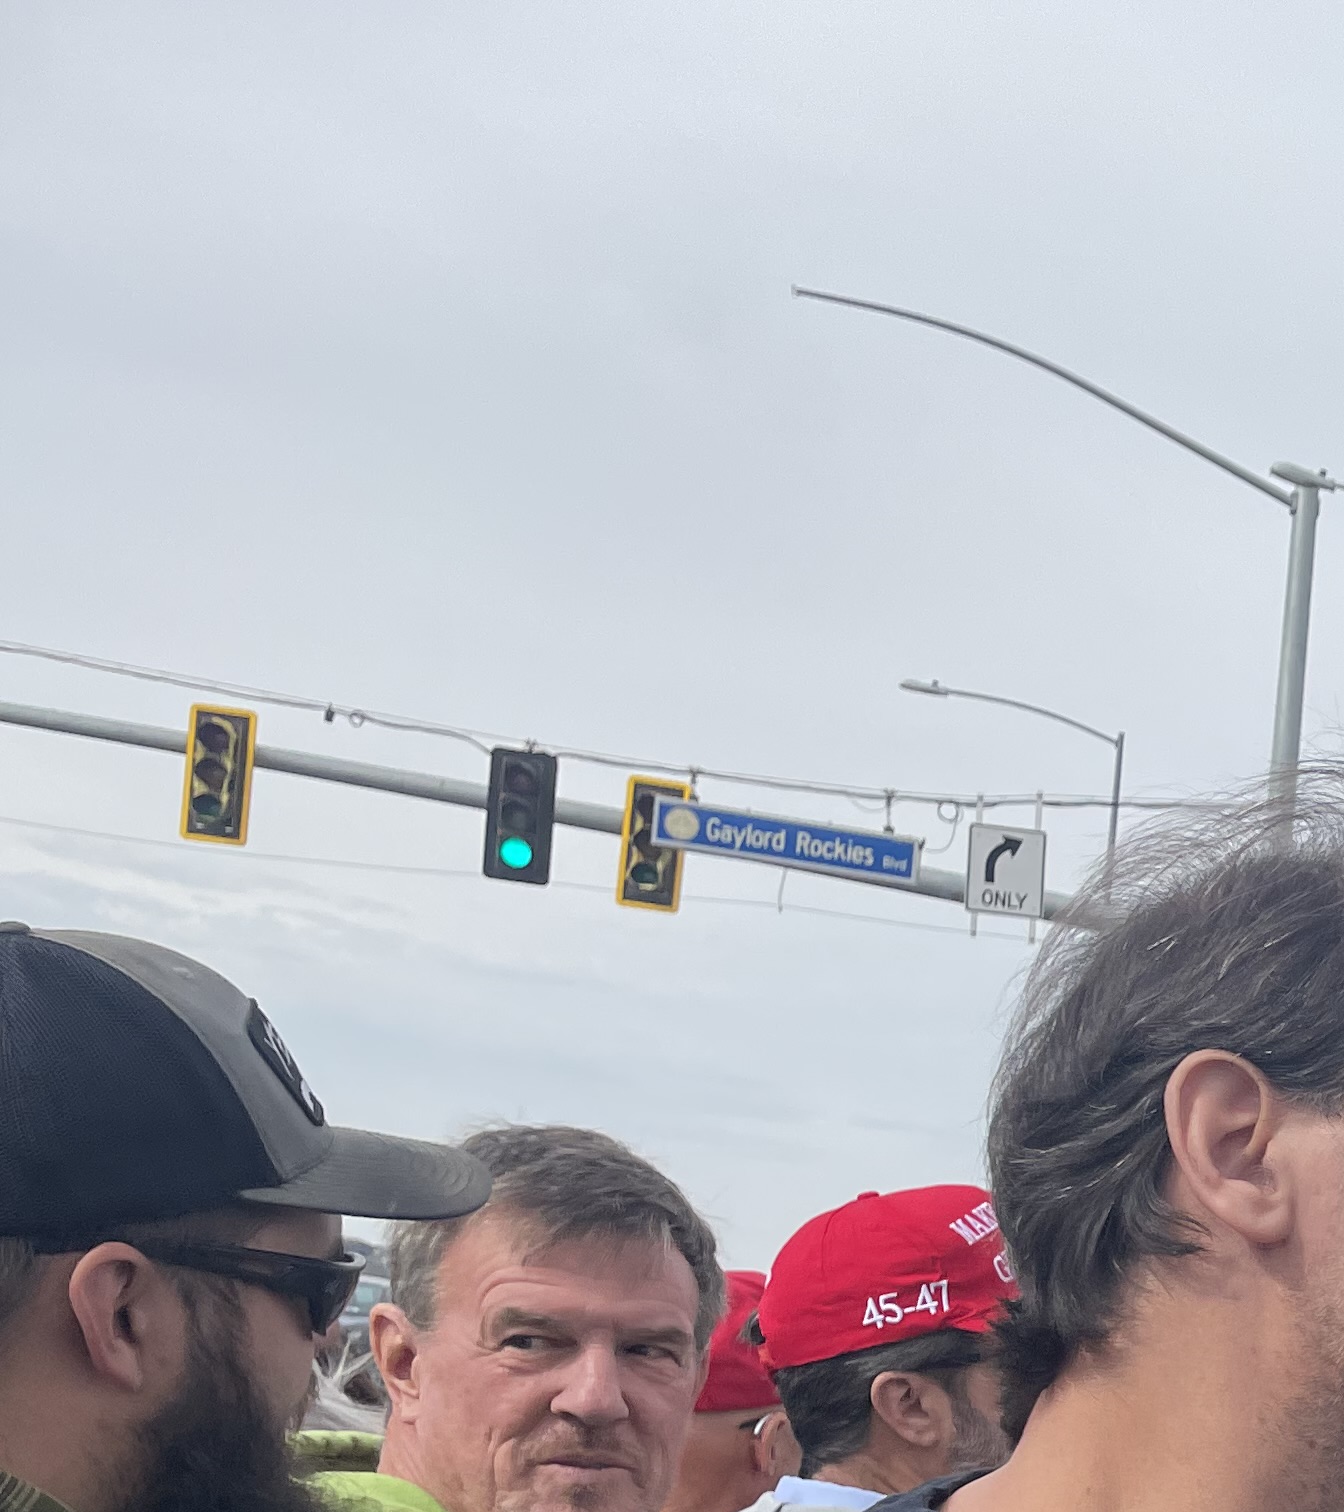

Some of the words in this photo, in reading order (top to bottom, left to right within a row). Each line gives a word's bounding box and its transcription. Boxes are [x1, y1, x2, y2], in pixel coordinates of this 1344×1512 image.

[706, 816, 787, 853] Gaylord
[795, 830, 875, 867] Rockies
[882, 854, 908, 873] Blvd
[981, 888, 1029, 911] ONLY
[862, 1279, 950, 1330] 45-47
